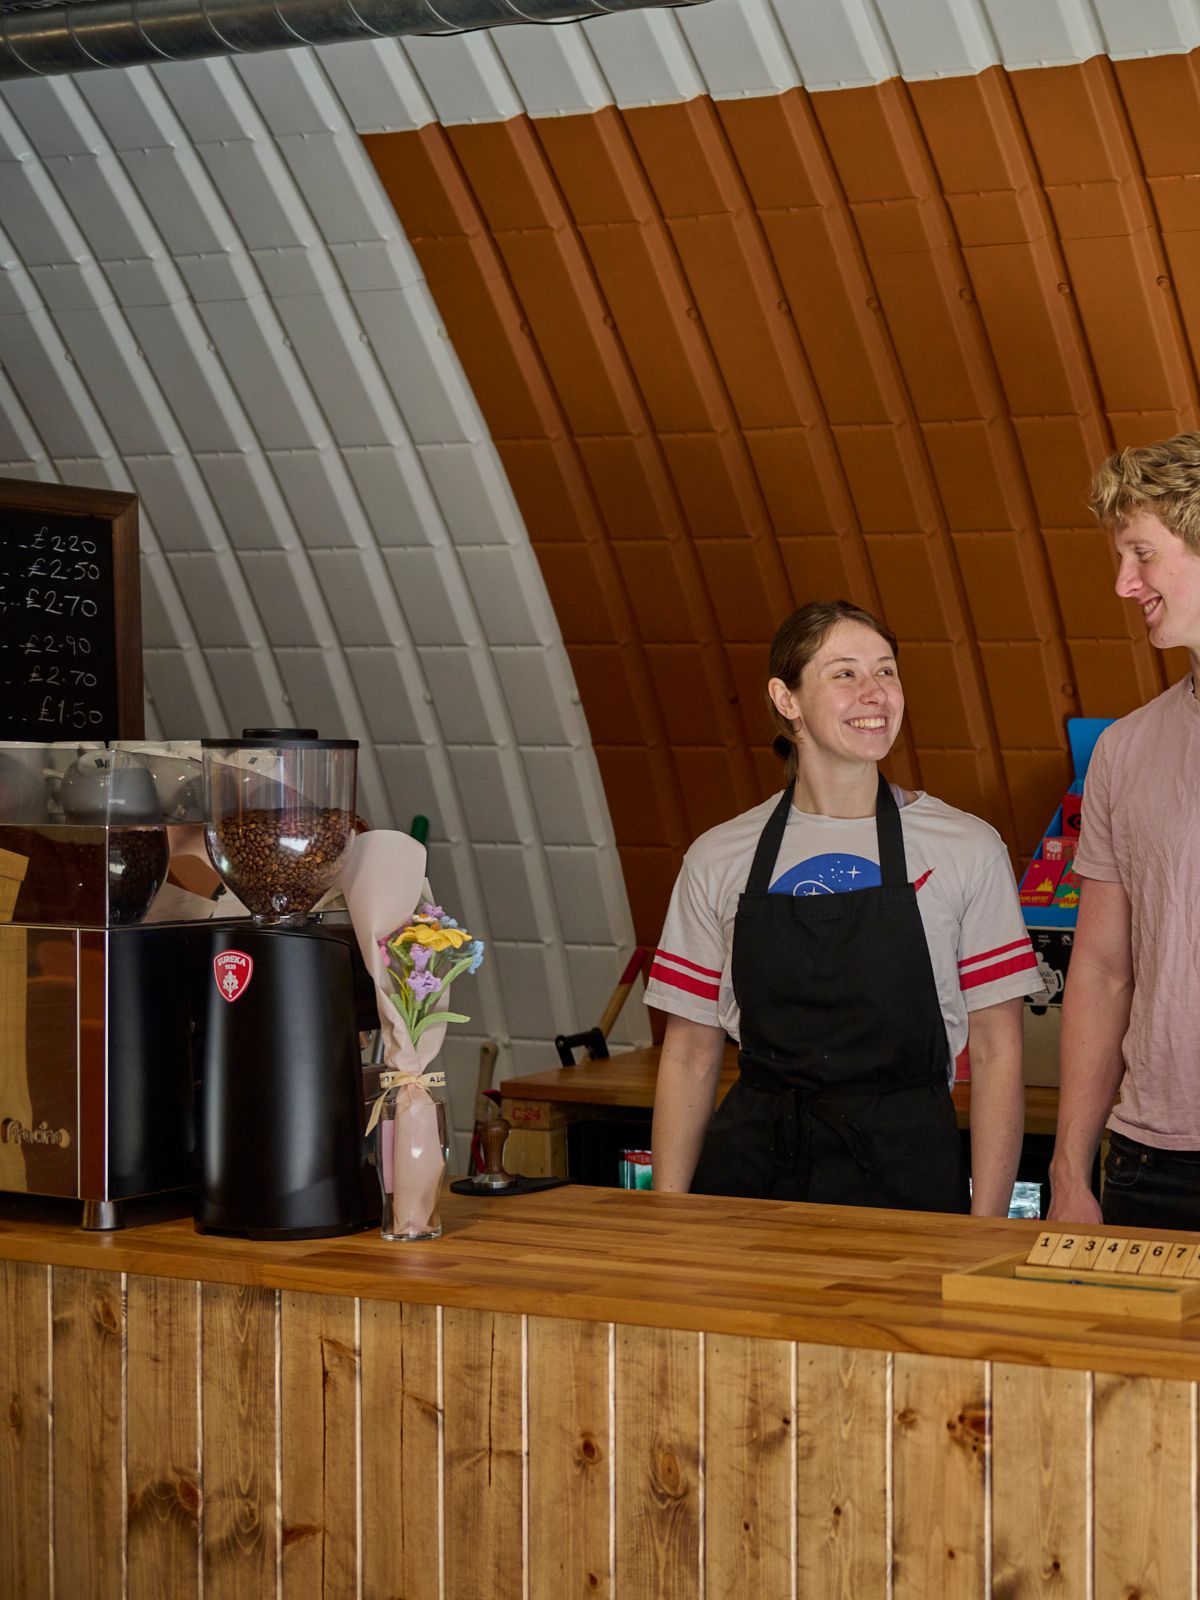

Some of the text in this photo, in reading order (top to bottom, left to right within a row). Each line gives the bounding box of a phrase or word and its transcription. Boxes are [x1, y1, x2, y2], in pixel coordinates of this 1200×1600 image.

[31, 526, 97, 554] £2.20
[27, 558, 100, 580] £2.50
[26, 588, 98, 617] £2.70
[25, 634, 91, 655] £2.90
[29, 665, 97, 687] £2.70
[38, 695, 103, 729] £1.50
[217, 955, 246, 967] EUREKA
[1040, 1237, 1050, 1247] 1
[1062, 1239, 1074, 1249] 2
[1084, 1240, 1096, 1251] 3
[1107, 1242, 1119, 1253] 4
[1129, 1244, 1141, 1255] 5
[1152, 1246, 1164, 1257] 6
[1176, 1247, 1187, 1258] 7
